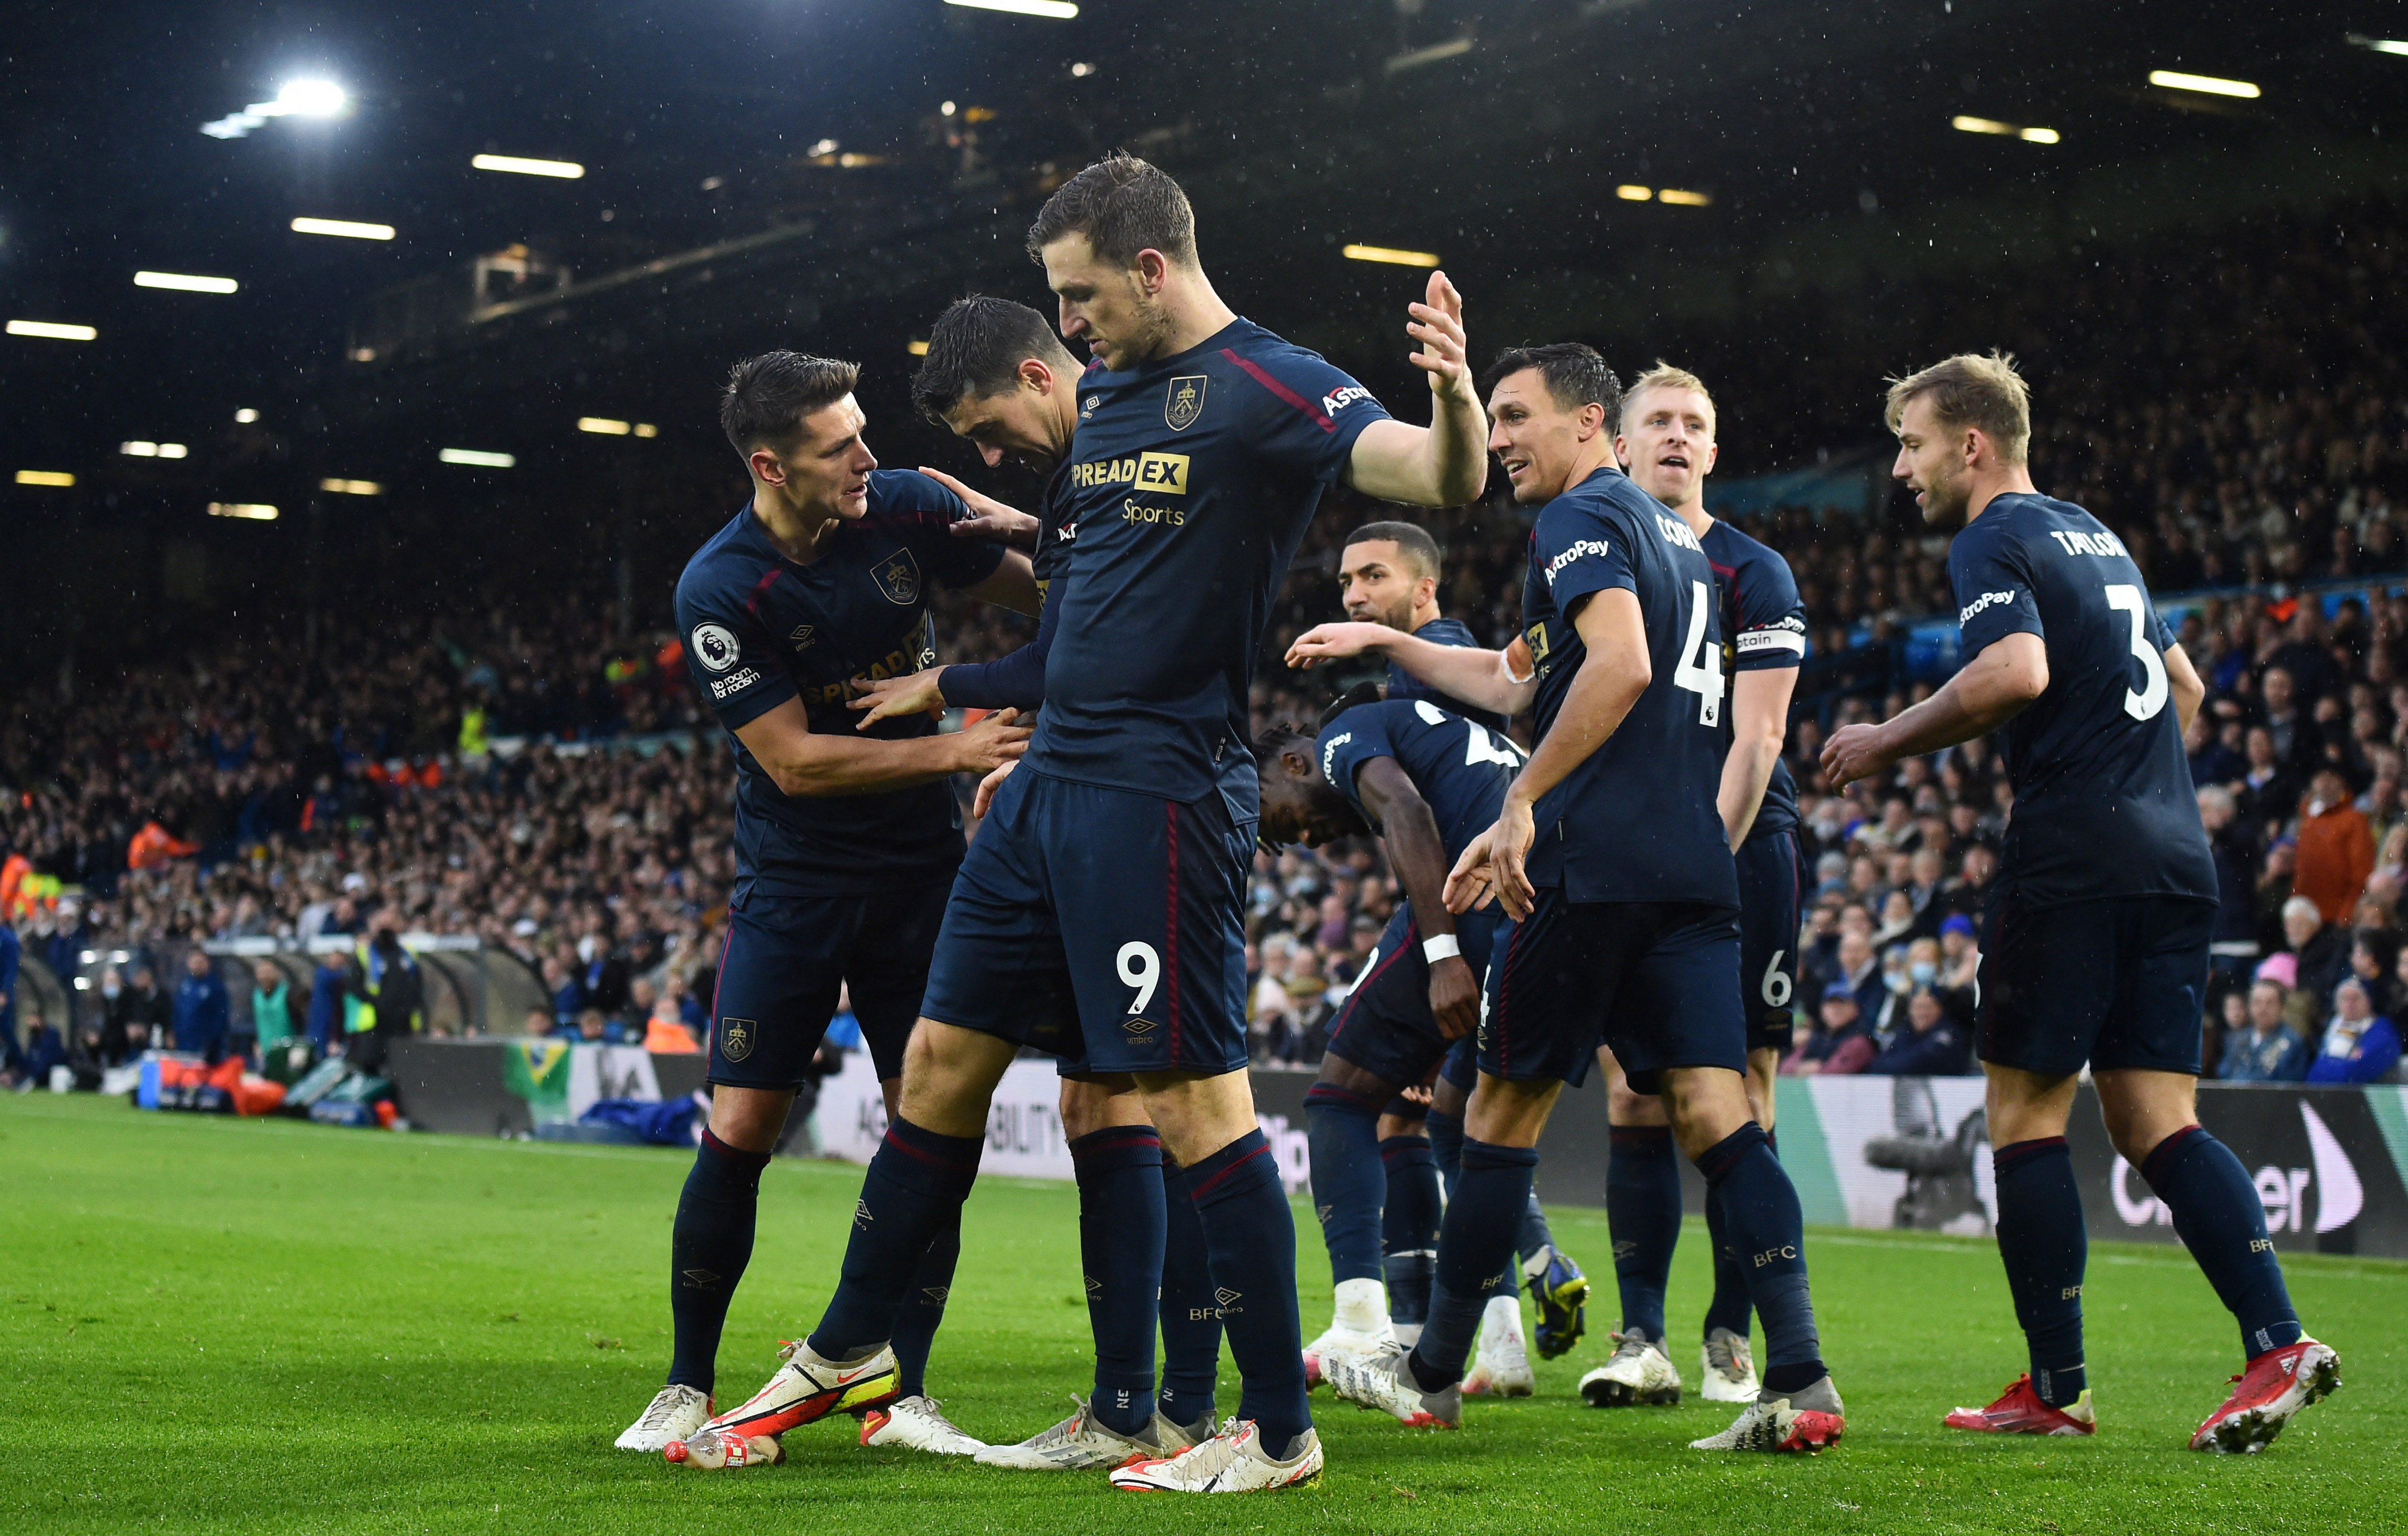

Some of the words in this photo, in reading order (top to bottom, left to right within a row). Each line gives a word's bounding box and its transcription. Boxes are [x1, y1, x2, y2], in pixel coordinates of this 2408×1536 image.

[1122, 498, 1185, 526] Sports
[2050, 531, 2127, 557] TAYLOR
[1544, 540, 1609, 587] AstroPay
[1960, 590, 2015, 630] stroPay
[1674, 580, 1725, 727] 4
[1738, 634, 1771, 649] ptain
[2104, 584, 2169, 721] 3
[710, 680, 724, 691] No
[723, 667, 752, 686] room
[714, 688, 727, 700] for
[727, 672, 761, 694] racism
[1116, 941, 1160, 1014] 9
[1762, 949, 1792, 1007] 6
[1127, 1036, 1153, 1045] umbro
[1753, 1245, 1797, 1268] BFC
[1481, 1274, 1503, 1290] BF
